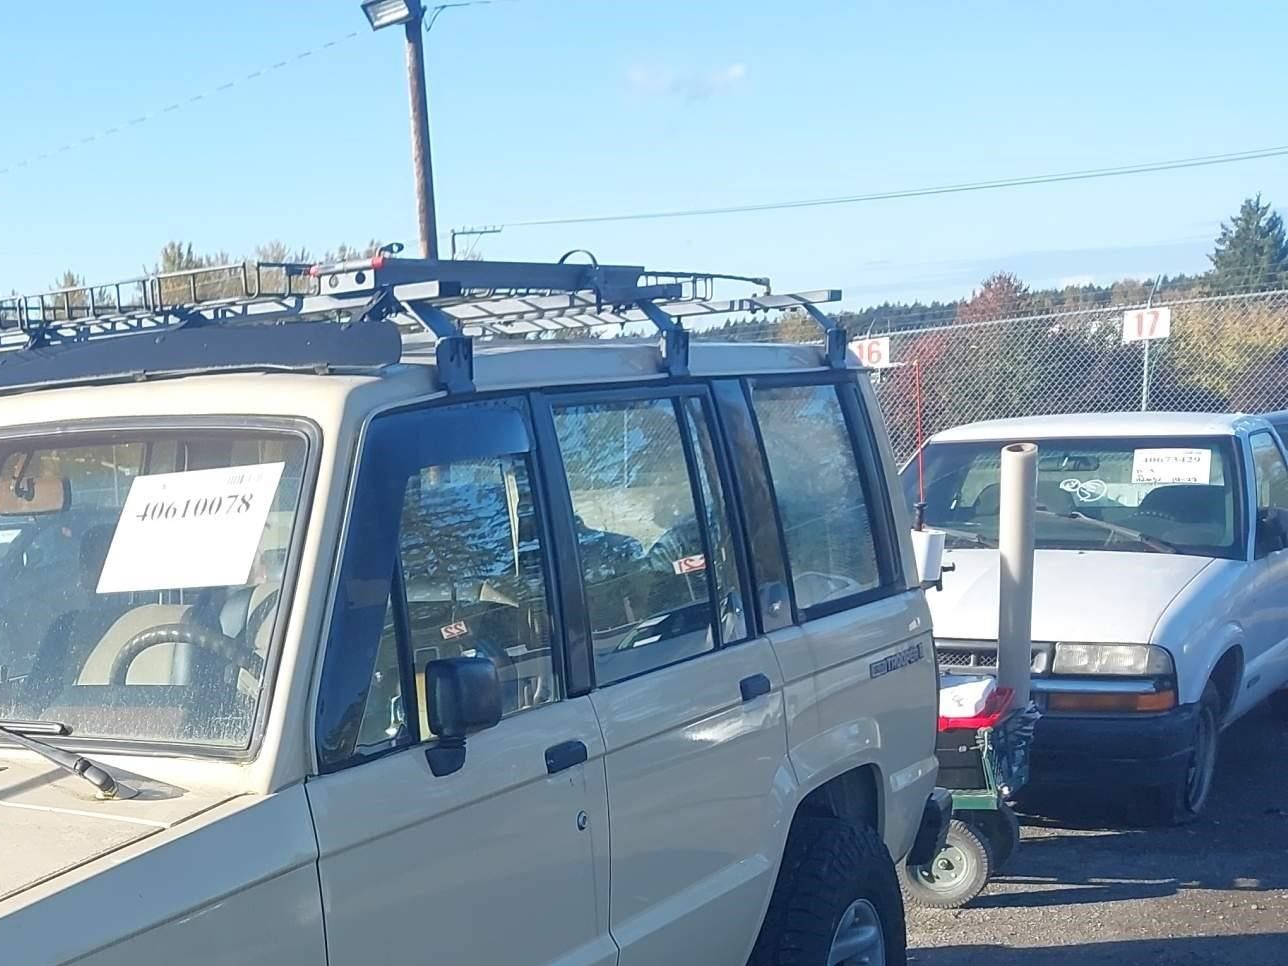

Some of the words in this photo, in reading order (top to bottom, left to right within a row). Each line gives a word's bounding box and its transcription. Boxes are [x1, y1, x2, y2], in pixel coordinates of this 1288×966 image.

[1135, 310, 1160, 337] 17
[856, 340, 882, 365] 16
[136, 492, 254, 522] 40610078
